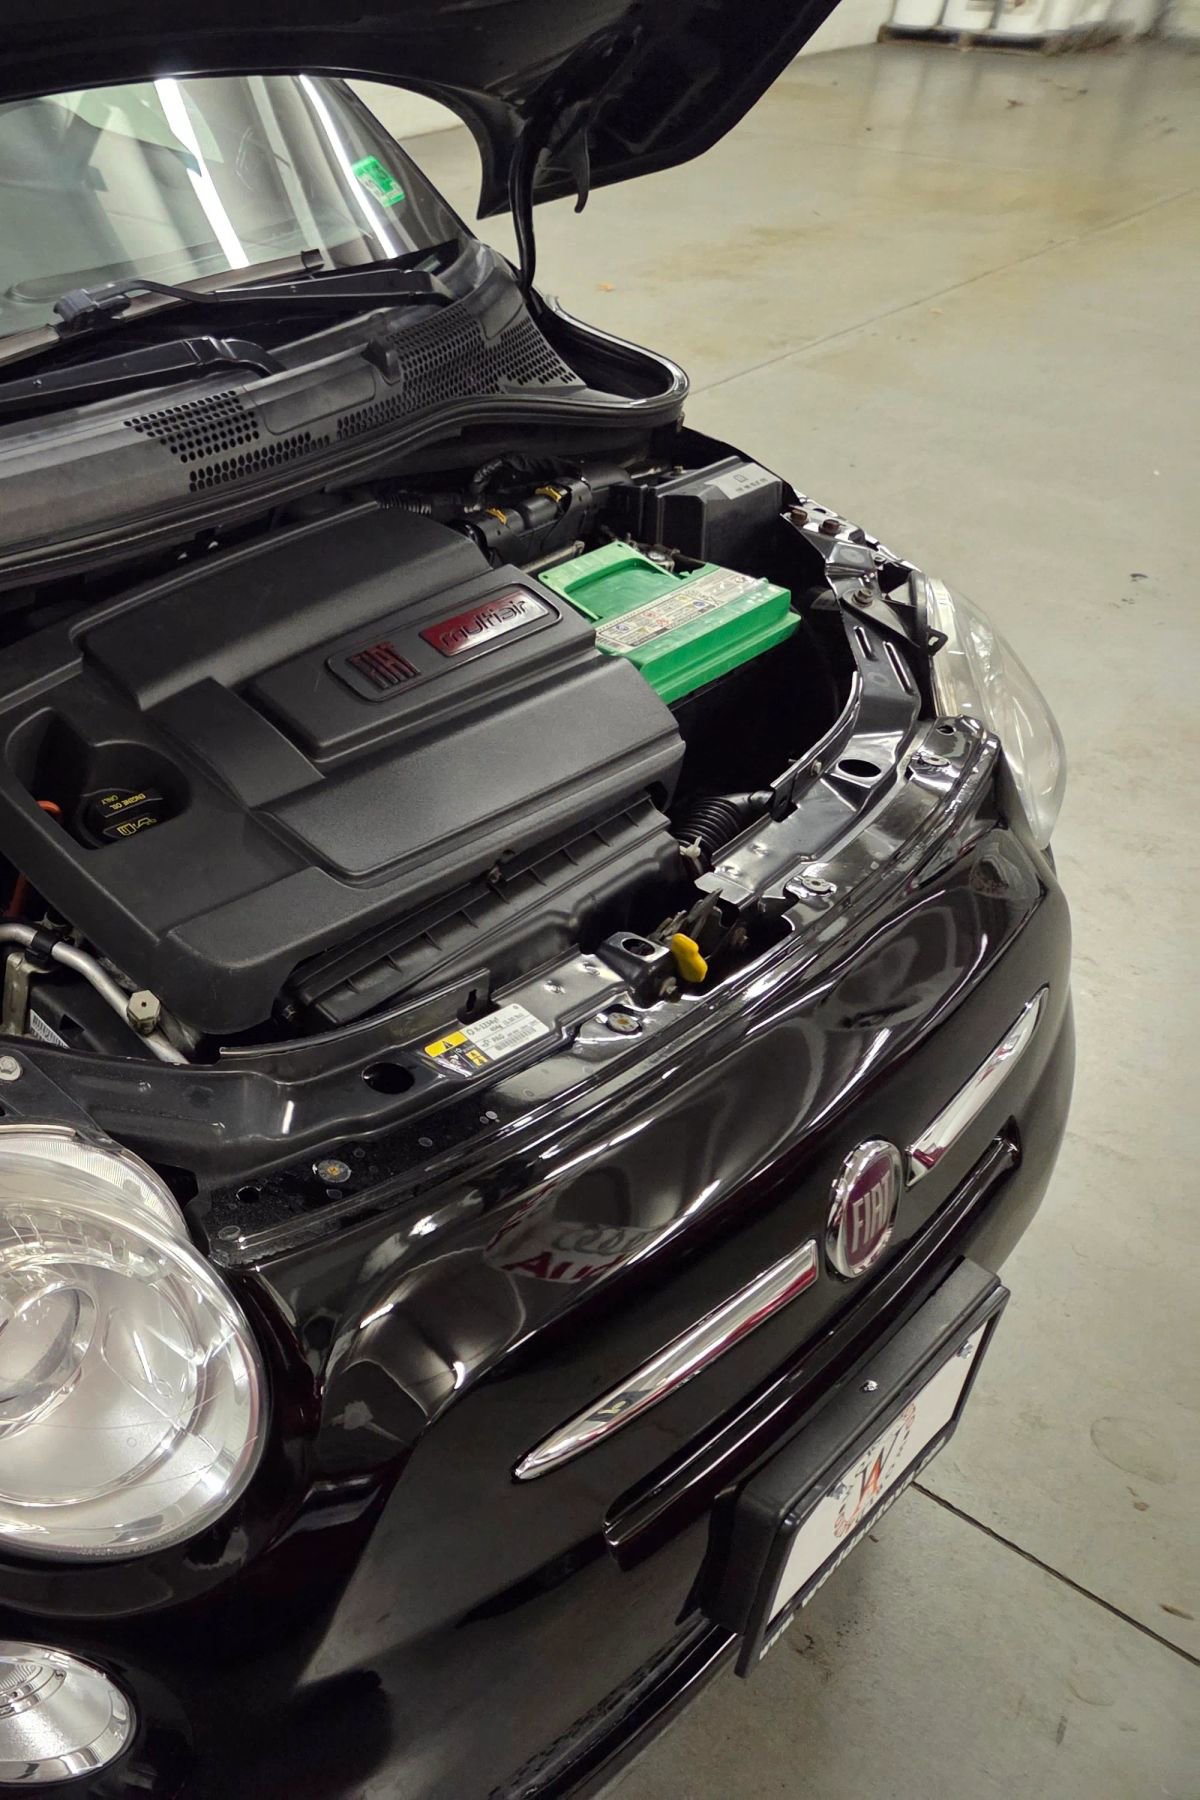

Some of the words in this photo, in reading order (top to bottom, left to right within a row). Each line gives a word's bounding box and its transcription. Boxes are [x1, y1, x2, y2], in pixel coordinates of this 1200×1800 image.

[440, 599, 532, 647] multiair
[345, 640, 421, 690] FIAT
[850, 1168, 891, 1254] FIAT
